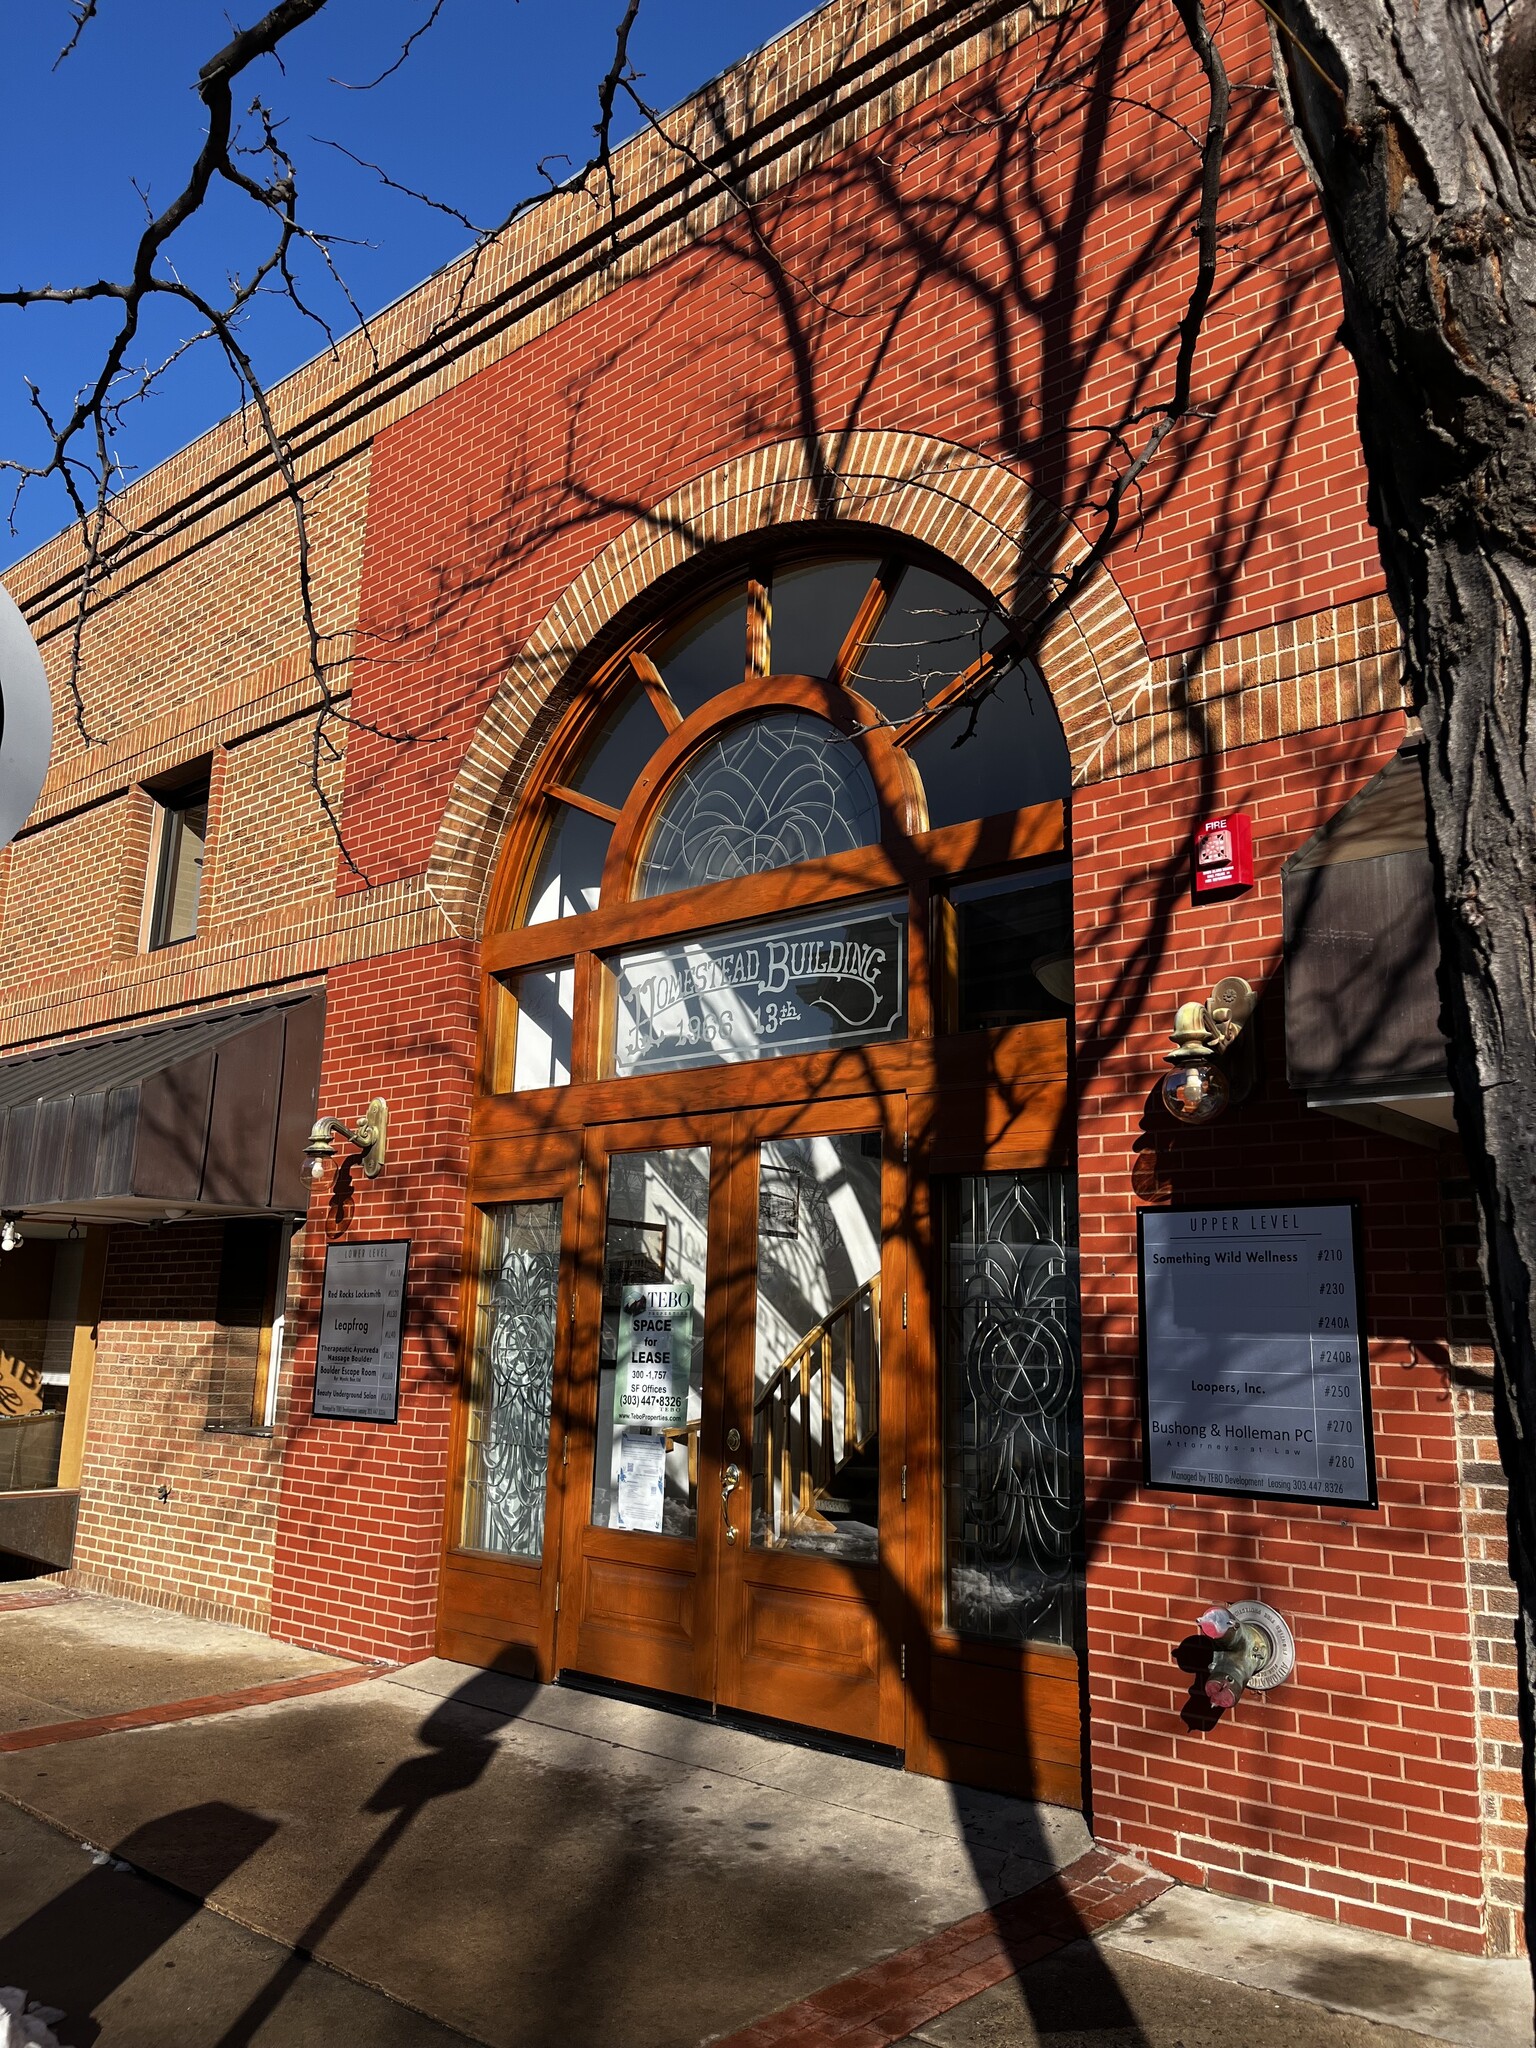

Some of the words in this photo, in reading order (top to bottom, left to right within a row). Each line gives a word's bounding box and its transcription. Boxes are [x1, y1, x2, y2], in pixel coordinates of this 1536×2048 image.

[1205, 819, 1227, 831] FIRE
[675, 1010, 734, 1047] 1966
[753, 1001, 801, 1036] 13th
[1190, 1216, 1239, 1232] UPPER
[1251, 1214, 1300, 1230] LEVEL
[344, 1249, 366, 1259] LOWER
[368, 1248, 388, 1258] LEVEL
[1152, 1251, 1211, 1266] Something
[1214, 1250, 1242, 1264] Wild
[1245, 1249, 1298, 1263] Wellness
[1317, 1249, 1343, 1262] #210
[328, 1289, 338, 1298] Red
[339, 1289, 354, 1298] Rocks
[355, 1288, 381, 1298] Locksmith
[1319, 1283, 1345, 1295] #230
[647, 1291, 691, 1308] TEBO
[334, 1317, 369, 1334] Leapfrog
[633, 1319, 672, 1332] SPACE
[1318, 1317, 1350, 1329] #240A
[644, 1337, 658, 1347] for
[321, 1345, 352, 1354] Therapeutic
[353, 1346, 379, 1355] Ayurveda
[327, 1354, 350, 1363] Massage
[351, 1355, 373, 1363] Boulder
[631, 1351, 670, 1364] LEASE
[1319, 1351, 1352, 1363] #240B
[320, 1366, 340, 1374] Boulder
[341, 1366, 360, 1377] Escape
[361, 1367, 377, 1376] Room
[632, 1370, 644, 1379] 300
[317, 1389, 332, 1398] Beauty
[333, 1389, 363, 1400] Underground
[363, 1391, 377, 1400] Salon
[630, 1384, 640, 1393] SF
[642, 1384, 667, 1394] Offices
[1191, 1380, 1240, 1396] Loopers,
[1244, 1382, 1266, 1395] Inc.
[1324, 1385, 1351, 1398] #250
[619, 1394, 640, 1408] (303)
[1151, 1420, 1207, 1439] Bushong
[1210, 1423, 1221, 1437] &
[1225, 1424, 1290, 1442] Holleman
[1294, 1429, 1314, 1443] PC
[1326, 1420, 1353, 1433] #270
[1328, 1456, 1355, 1469] #280
[1170, 1470, 1198, 1482] Managed
[1199, 1471, 1206, 1483] by
[1207, 1472, 1223, 1484] TEBO
[1224, 1473, 1264, 1487] Development
[1267, 1478, 1291, 1491] Leasing
[1292, 1480, 1344, 1494] 303.447.8326
